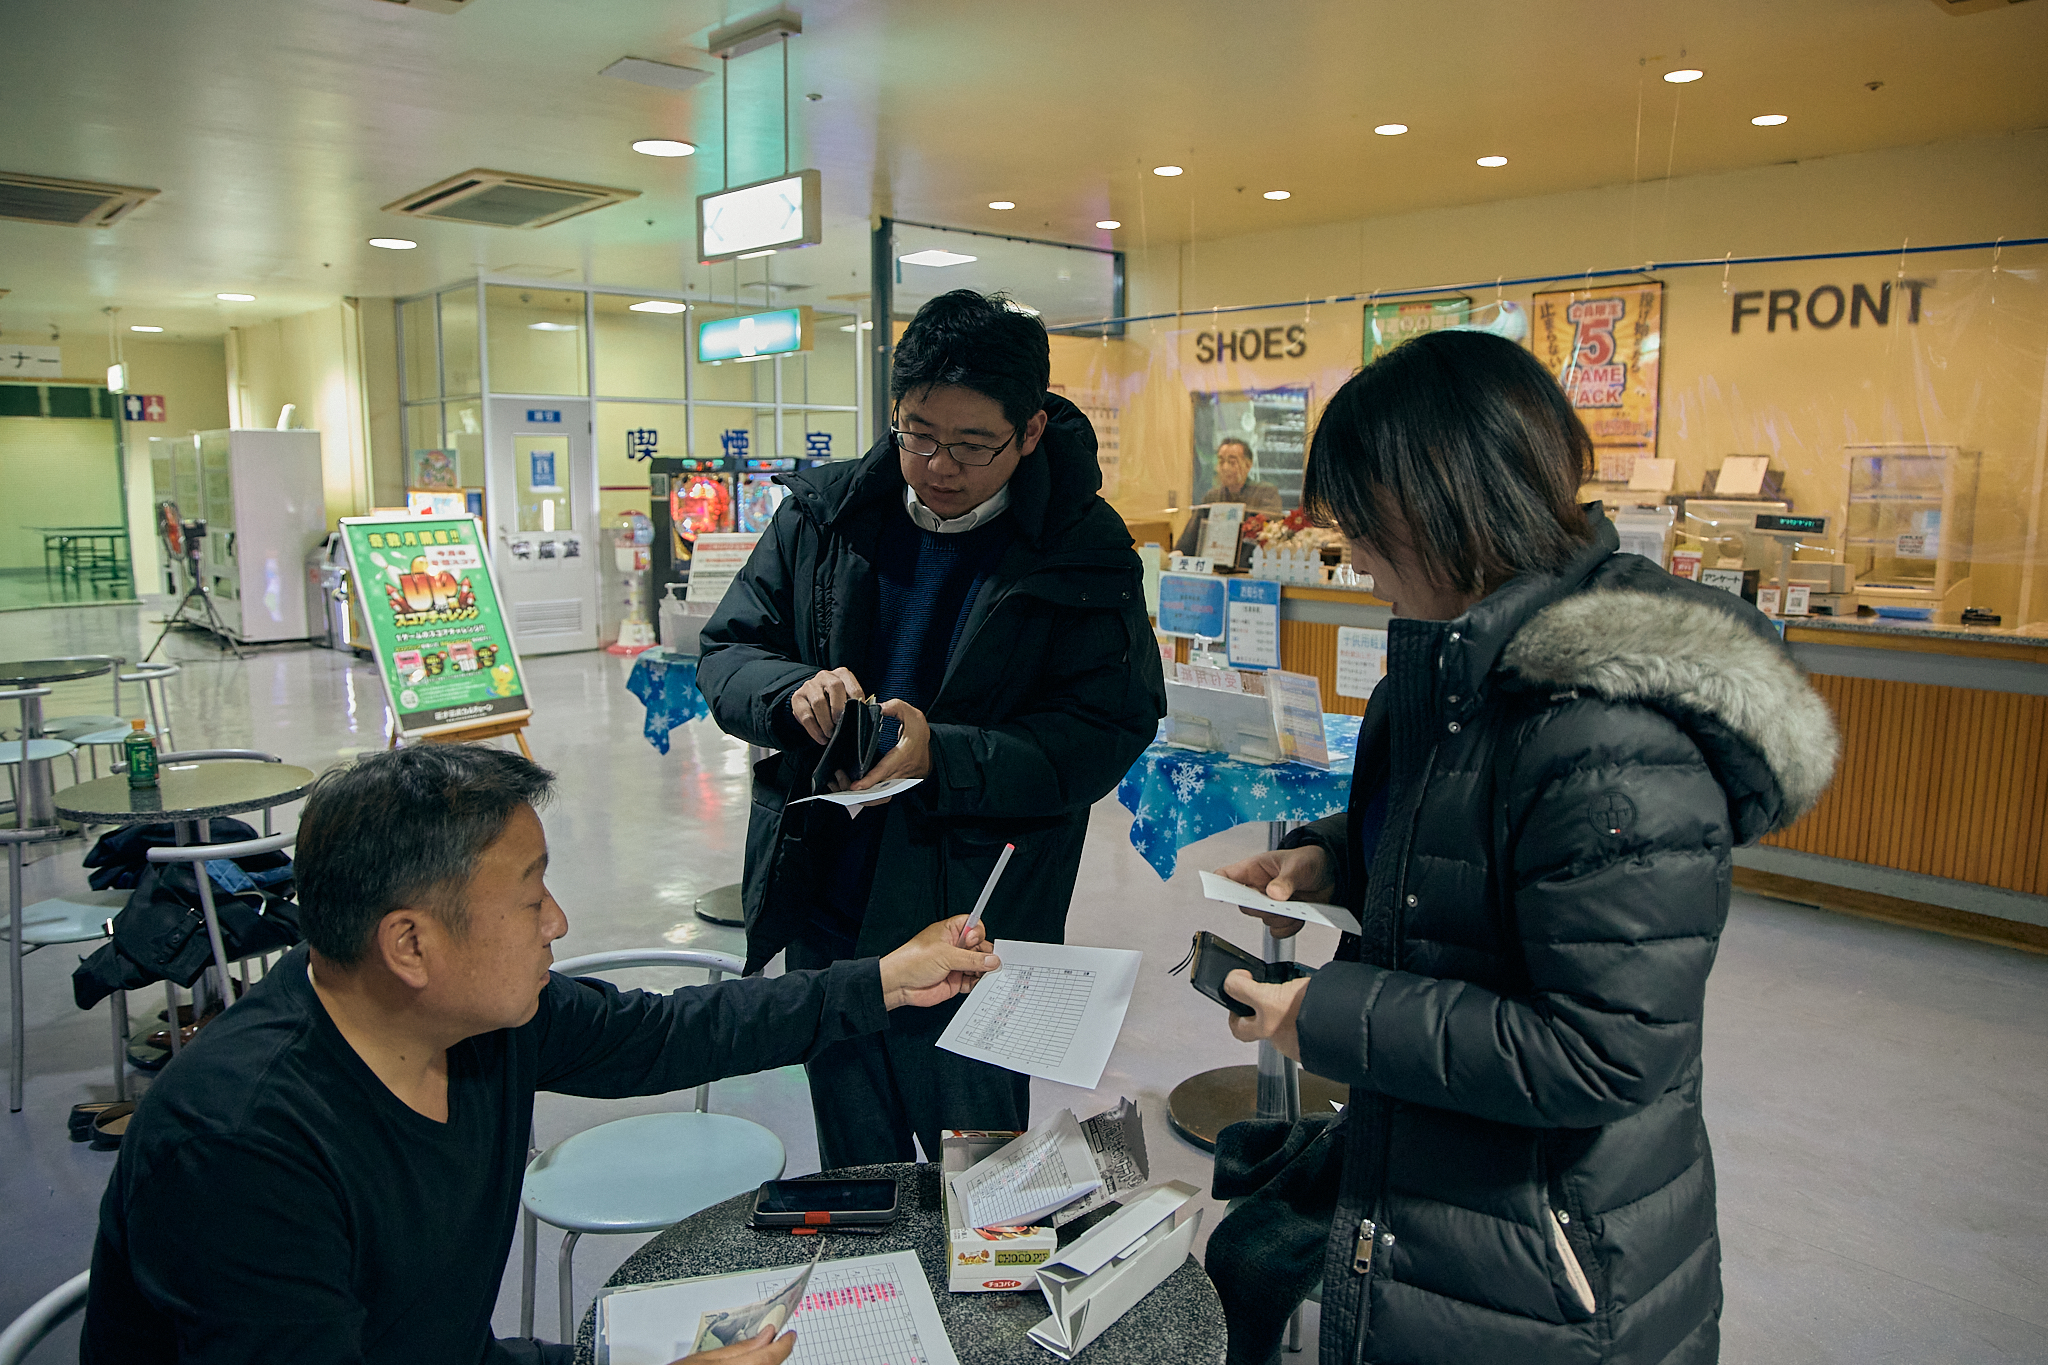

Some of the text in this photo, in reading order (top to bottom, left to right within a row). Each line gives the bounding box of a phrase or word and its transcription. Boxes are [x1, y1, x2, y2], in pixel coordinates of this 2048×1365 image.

[1731, 278, 1937, 334] FRONT
[1196, 324, 1307, 364] SHOES
[1577, 318, 1614, 366] 5
[0, 351, 59, 368] ナー
[1565, 366, 1621, 384] GAME
[627, 428, 832, 462] 喫煙室
[1178, 559, 1206, 571] 受付
[997, 1253, 1031, 1264] CHOCO
[988, 1280, 1017, 1288] チョコパイ
